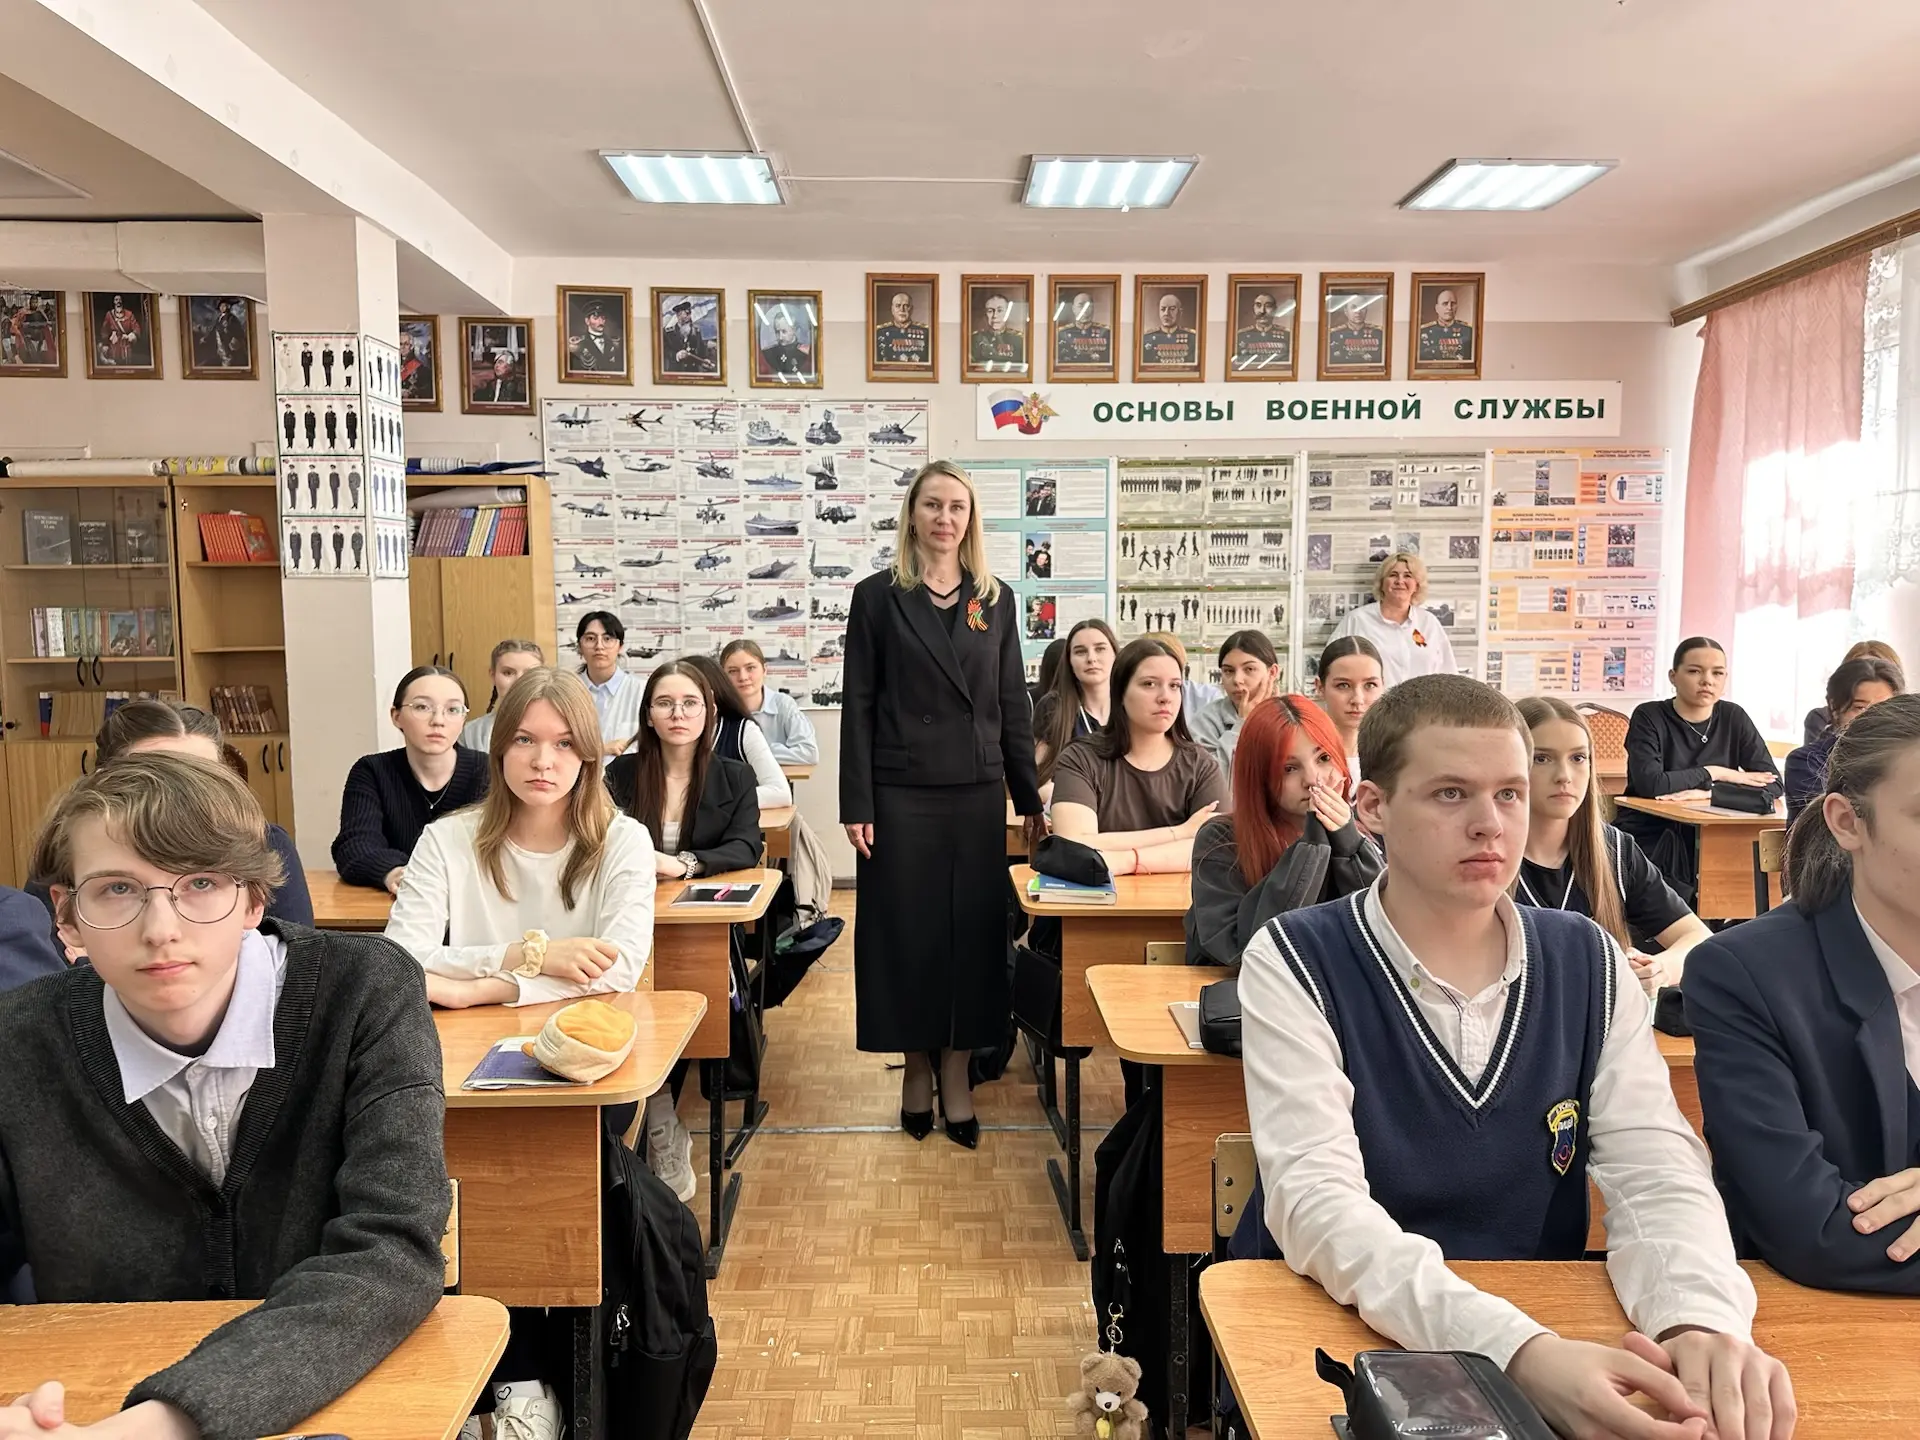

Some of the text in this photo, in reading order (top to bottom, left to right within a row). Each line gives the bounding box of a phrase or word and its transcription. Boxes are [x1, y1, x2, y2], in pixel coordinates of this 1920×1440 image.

[1093, 392, 1605, 422] ОСНОВЫ ВОЕННОЙ СЛУЖБЫ
